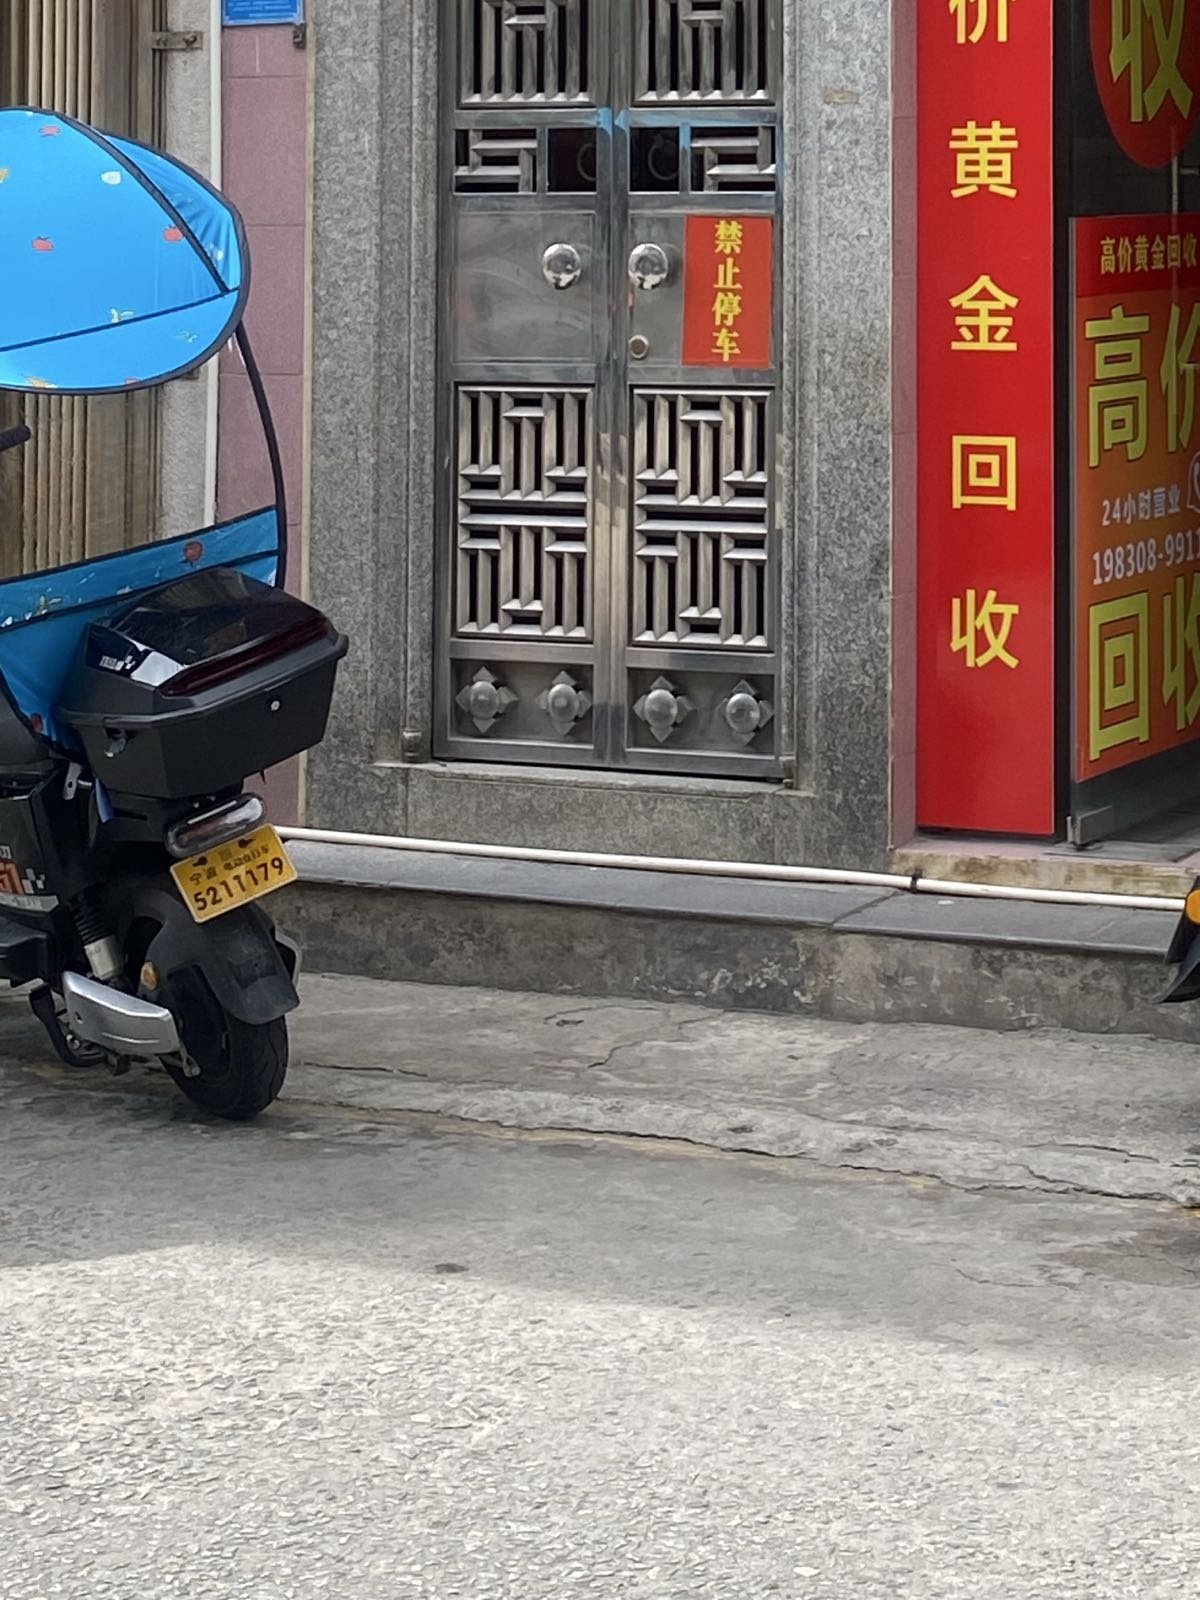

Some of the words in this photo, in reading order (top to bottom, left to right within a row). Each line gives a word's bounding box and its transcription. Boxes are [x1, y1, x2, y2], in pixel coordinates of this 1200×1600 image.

[1100, 233, 1198, 275] 高价黄金回收
[711, 220, 744, 362] 禁止停车
[1102, 484, 1181, 527] 24小时营业
[193, 856, 284, 912] 5211179
